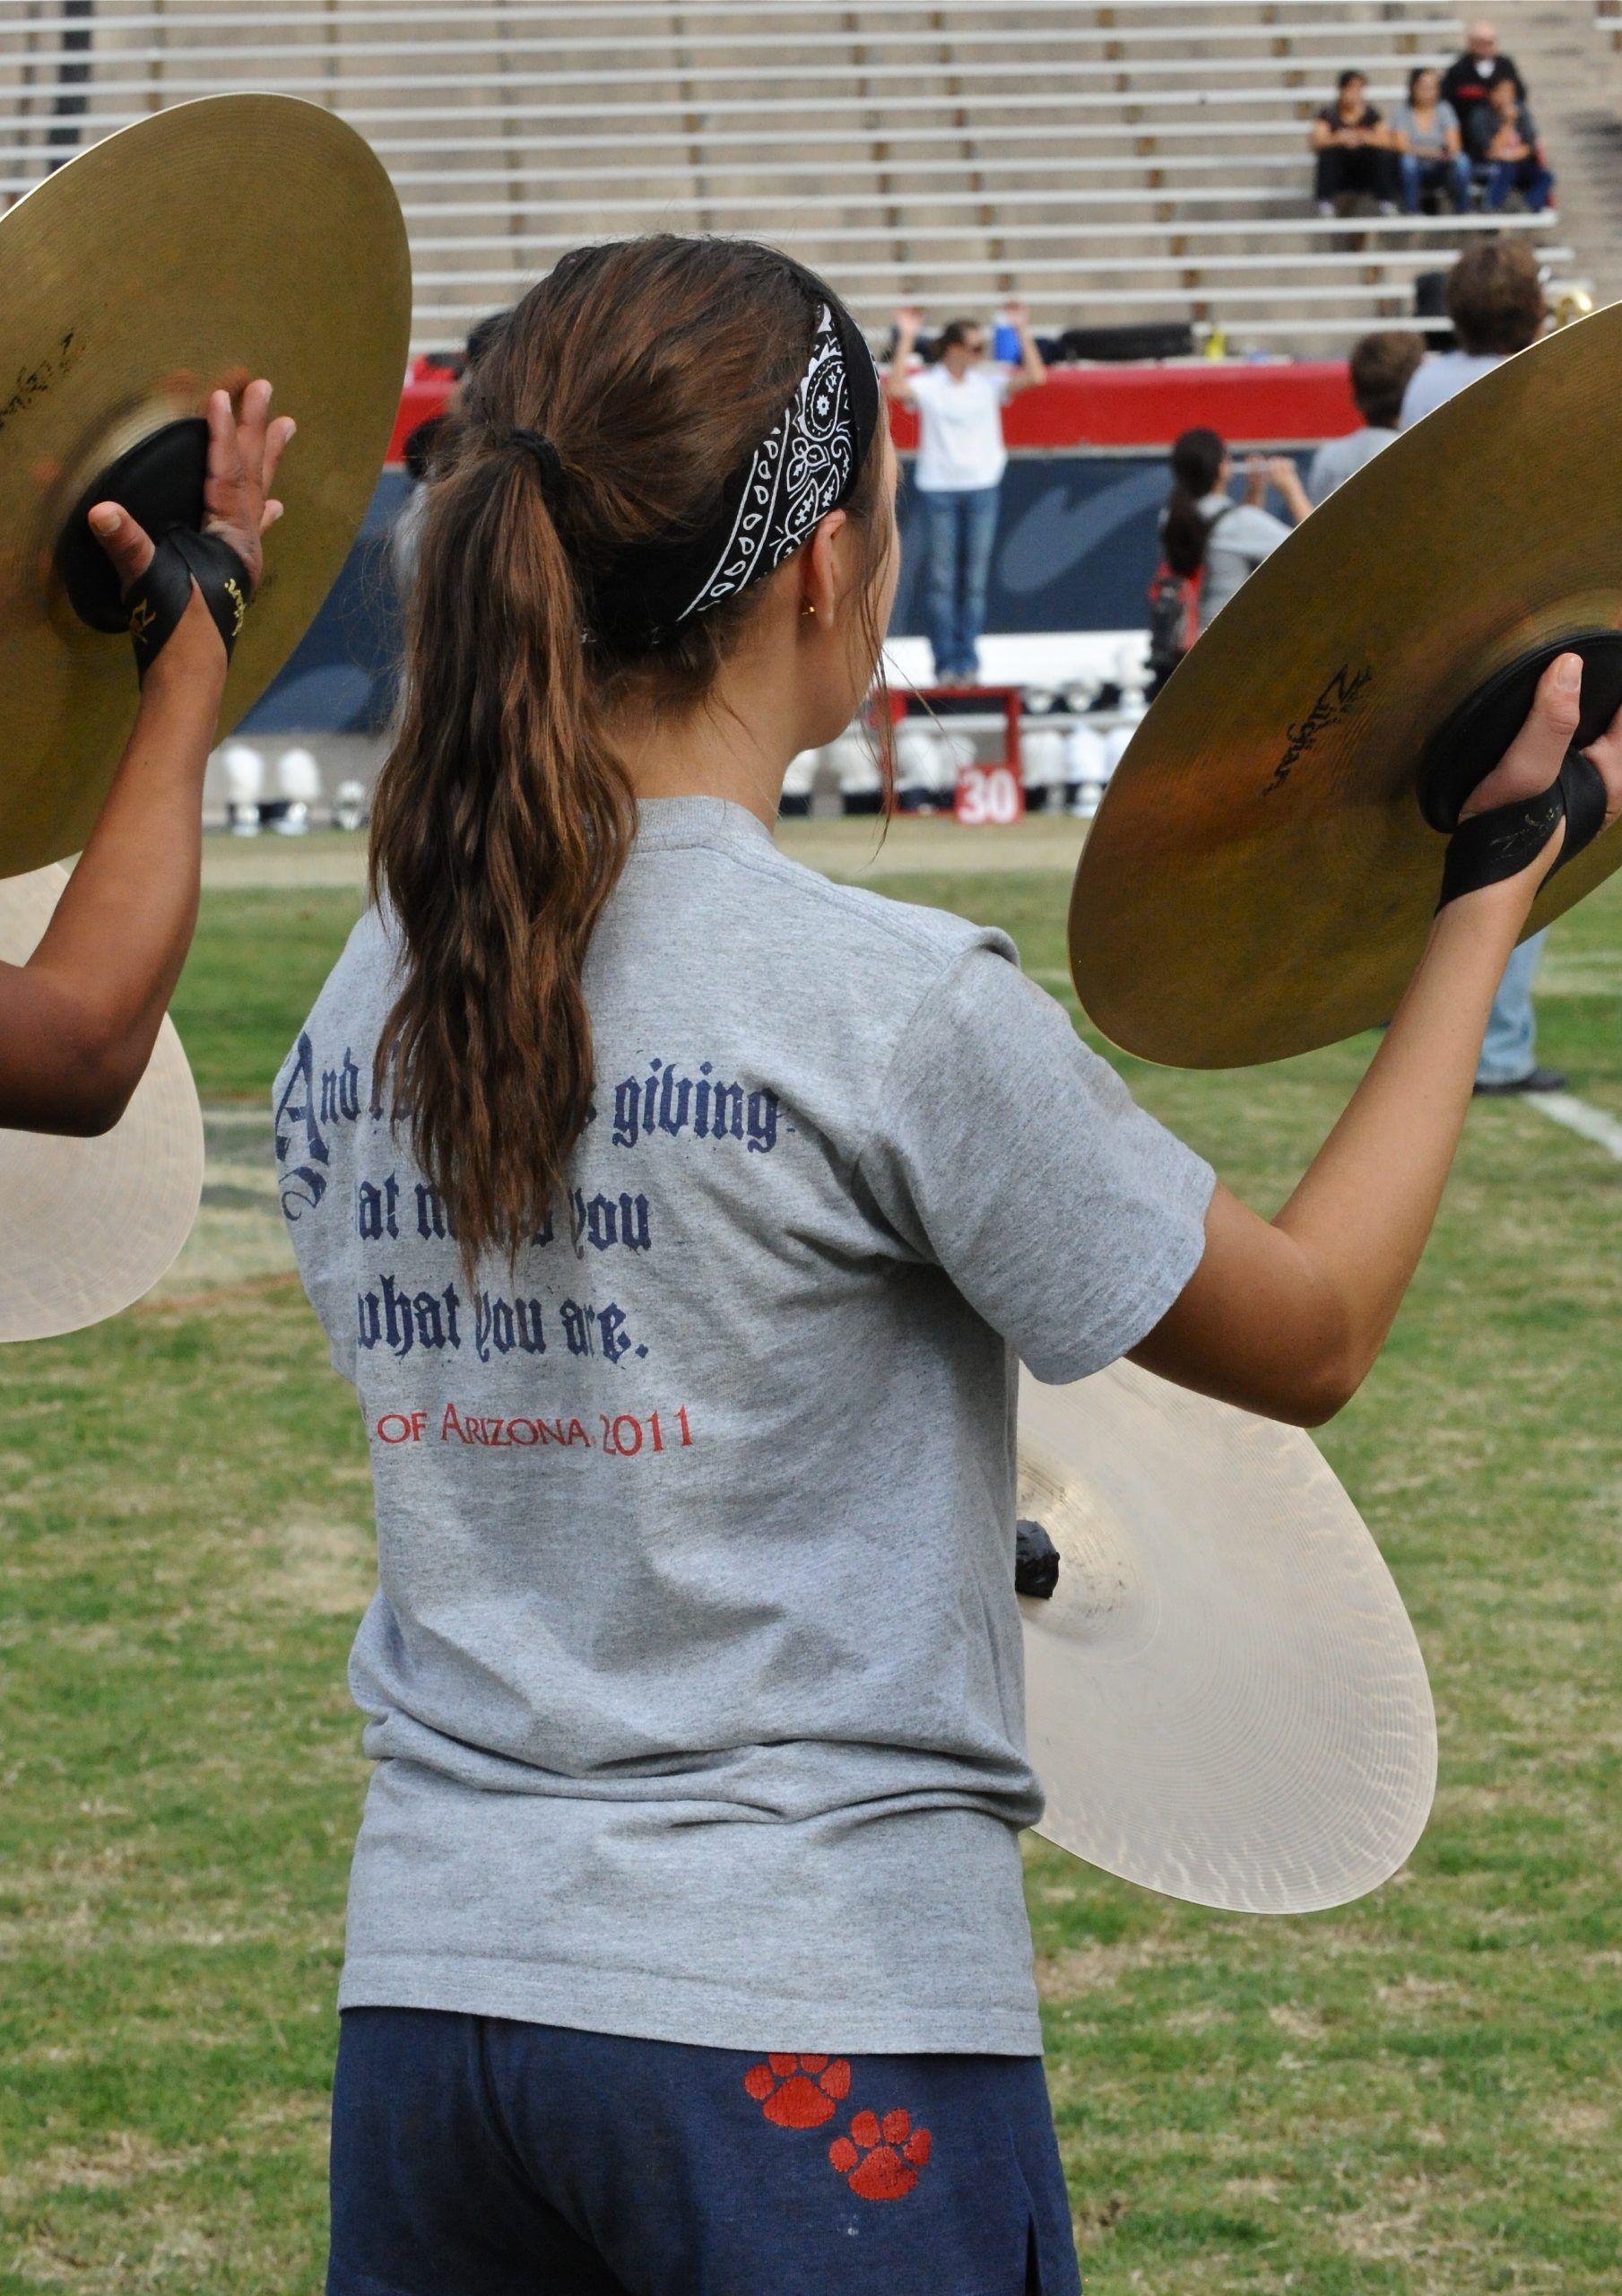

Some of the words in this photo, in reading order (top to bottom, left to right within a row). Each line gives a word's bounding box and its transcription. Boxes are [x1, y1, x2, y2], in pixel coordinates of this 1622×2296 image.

[956, 768, 1019, 823] 30
[275, 1031, 360, 1166] And
[568, 1188, 652, 1259] you
[475, 1292, 546, 1363] you
[377, 1413, 428, 1444] OF
[599, 1405, 693, 1457] 2011
